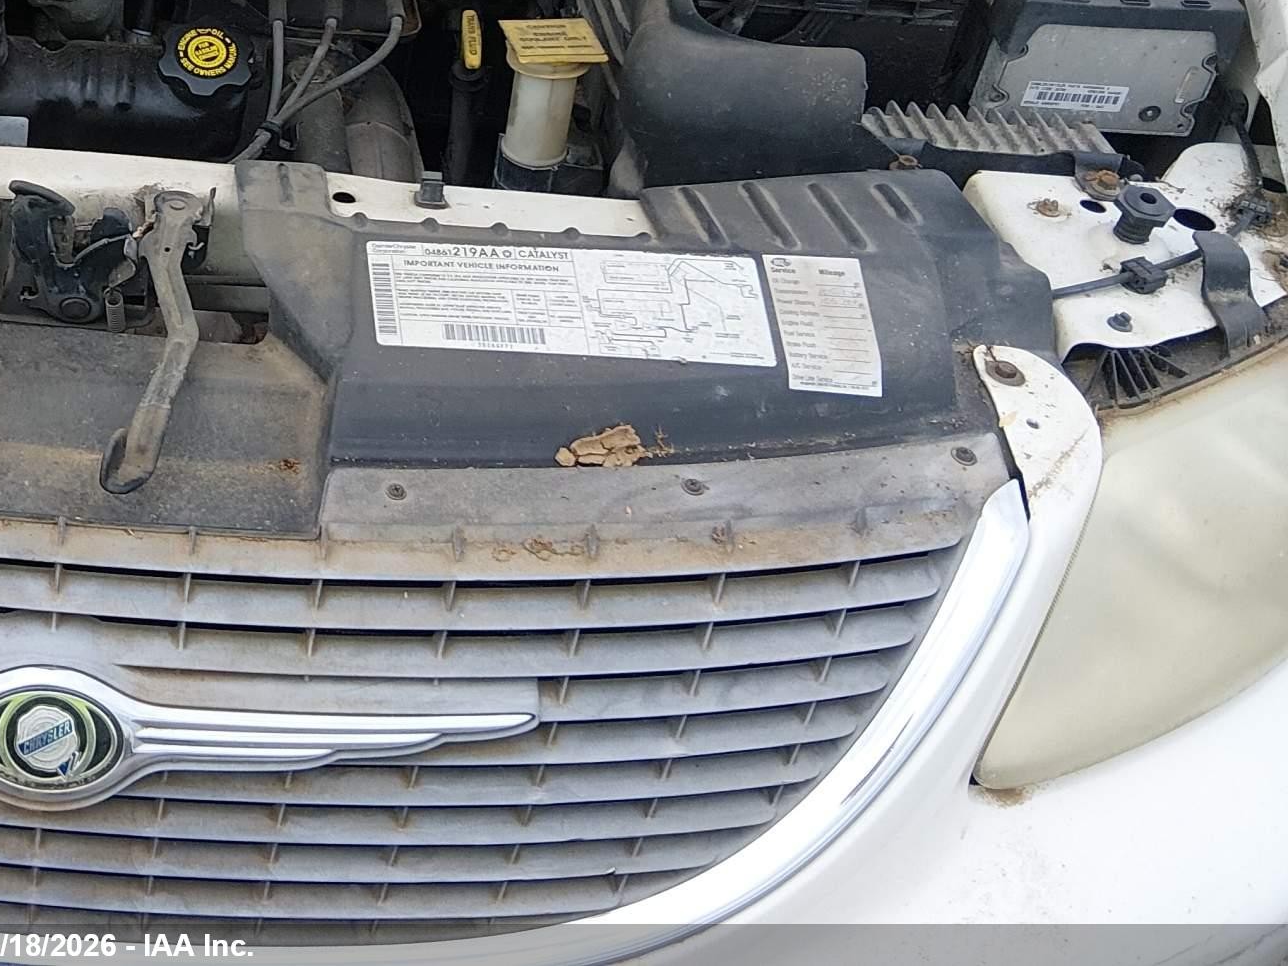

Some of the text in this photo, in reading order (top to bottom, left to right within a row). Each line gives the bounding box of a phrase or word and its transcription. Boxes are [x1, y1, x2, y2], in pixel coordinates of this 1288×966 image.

[178, 28, 225, 50] ENGINE OIL
[468, 36, 478, 55] FLUID
[180, 42, 238, 76] SEE OWNERS MANUAL
[518, 249, 569, 260] CATALYST
[403, 259, 560, 272] IMPORTANT VEHICLE INFORMATION
[818, 268, 846, 277] Mileage
[23, 719, 72, 755] CHRYSLER
